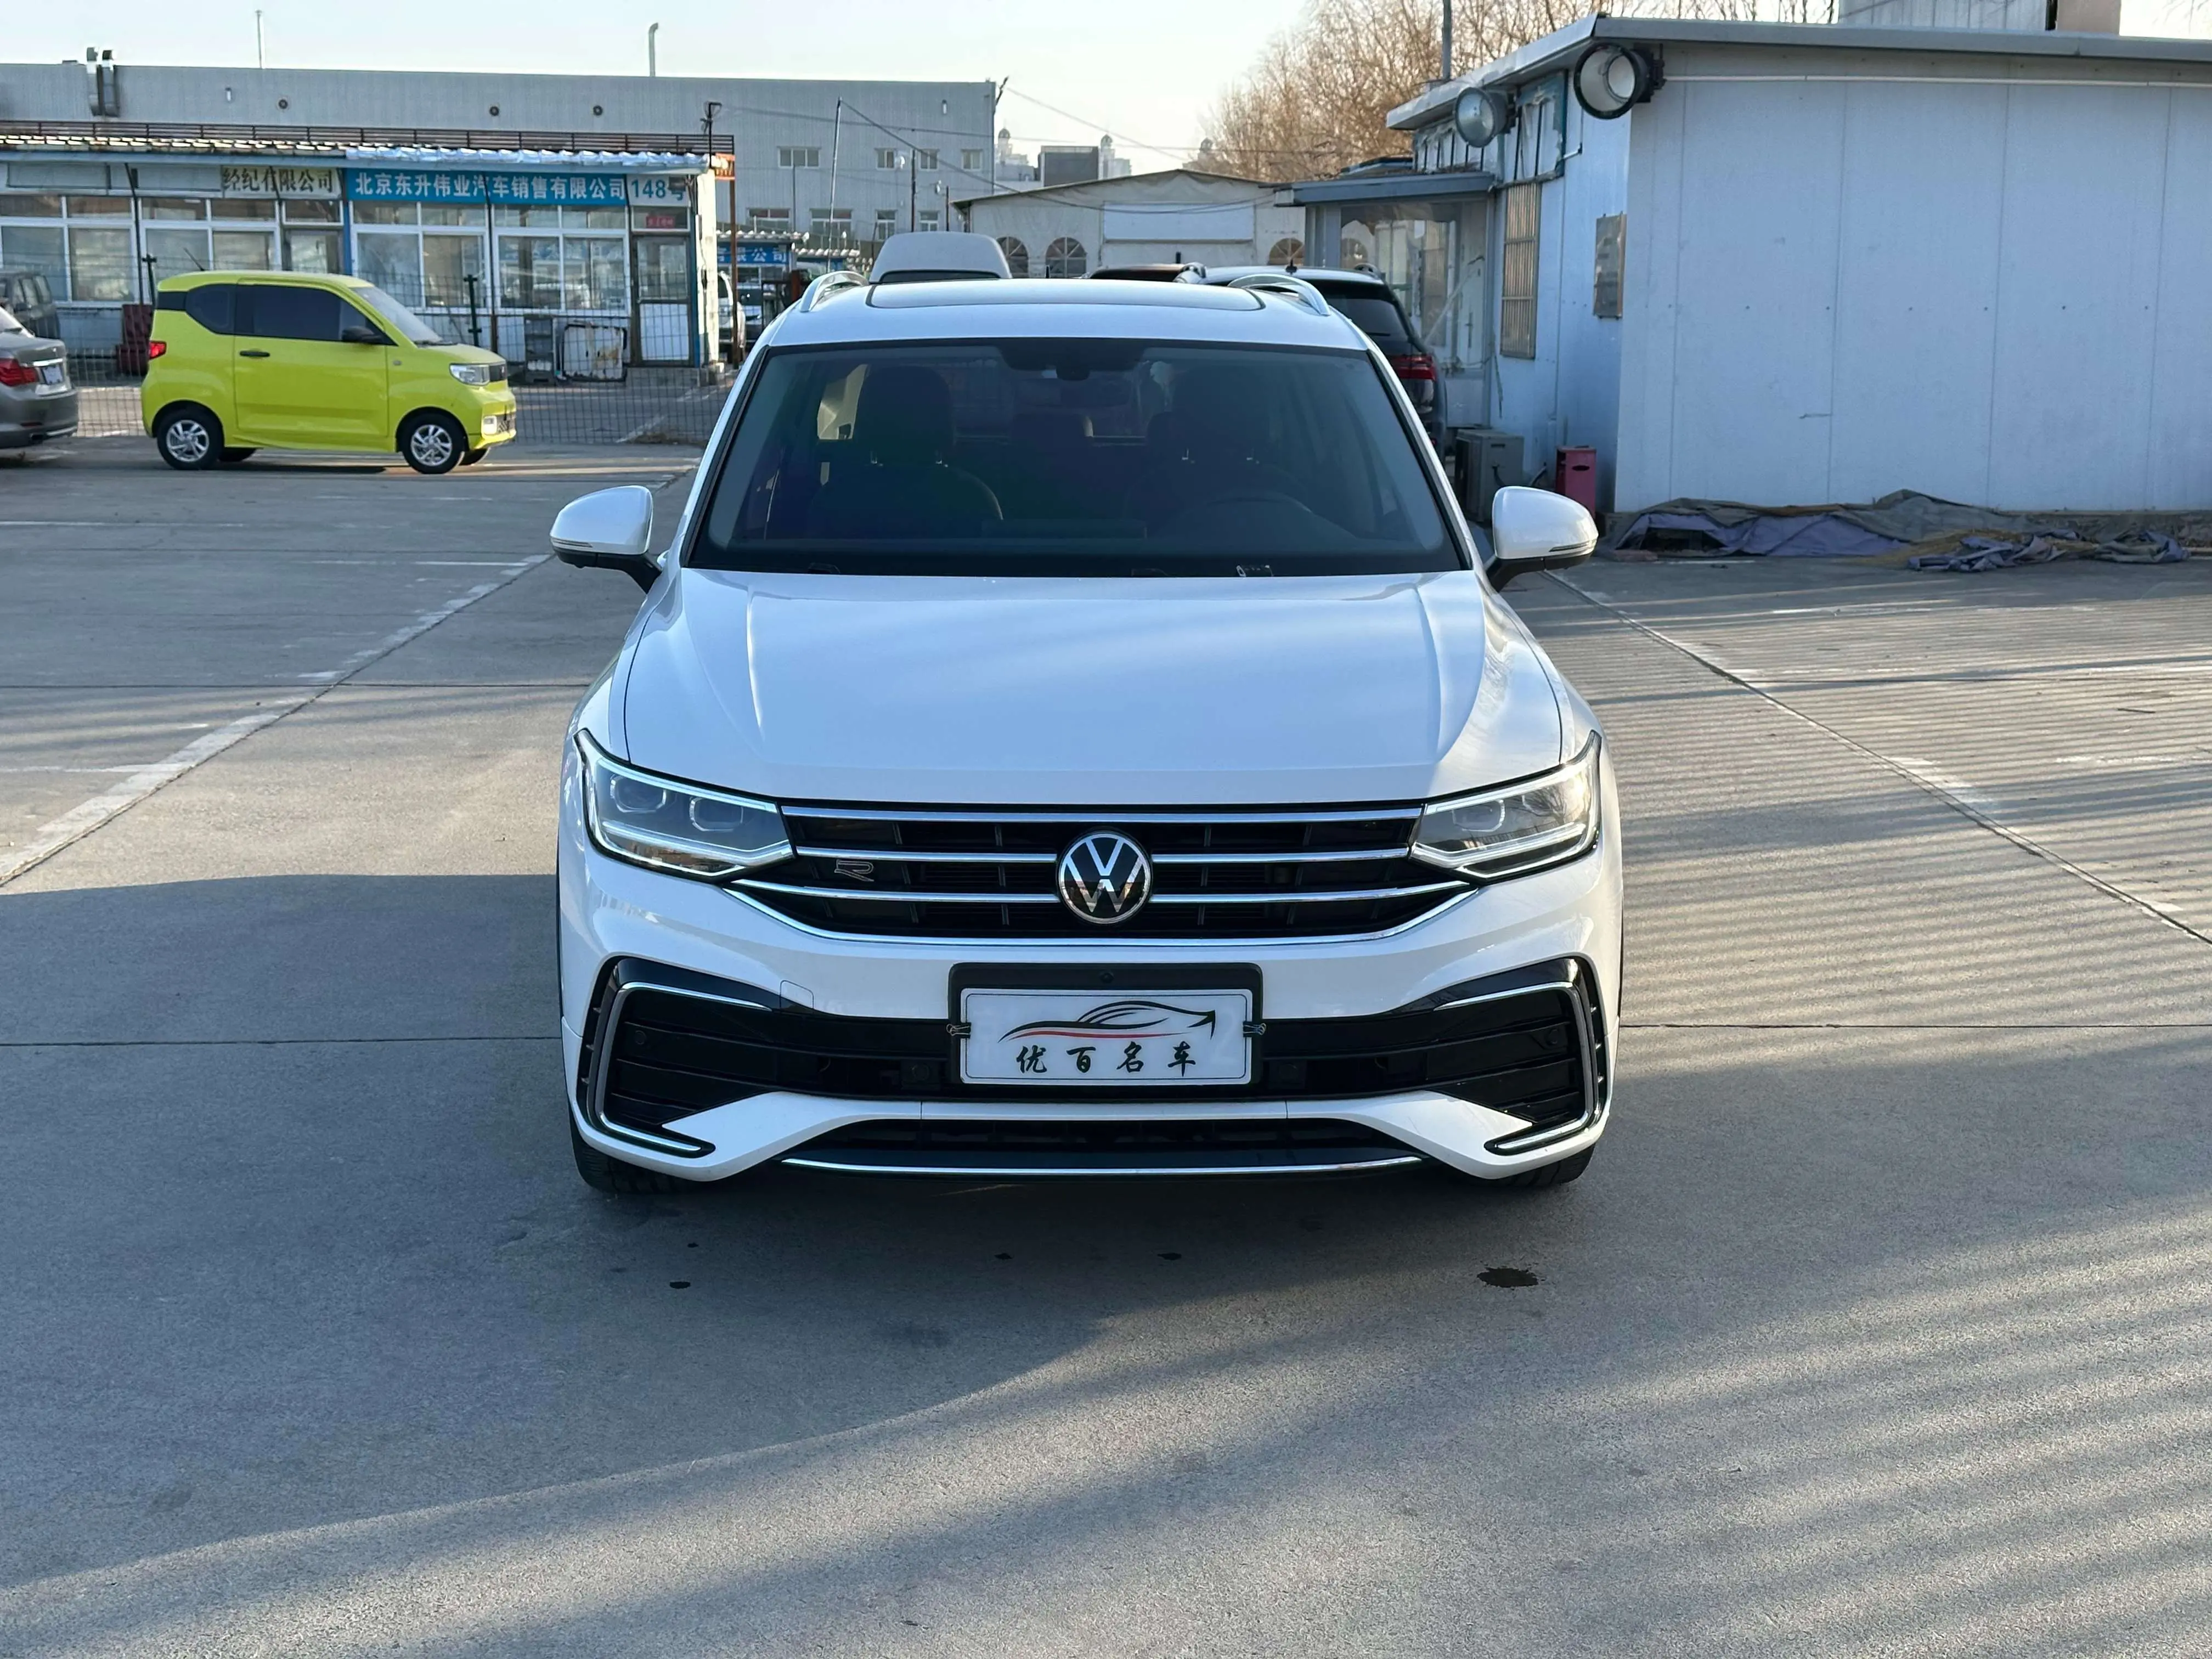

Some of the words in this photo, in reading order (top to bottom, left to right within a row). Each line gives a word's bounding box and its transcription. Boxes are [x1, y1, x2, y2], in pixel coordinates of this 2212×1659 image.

[356, 172, 625, 200] 北京东升伟业汽车销售有限公司
[1064, 833, 1146, 915] VW
[1016, 1041, 1196, 1077] 优百名车
